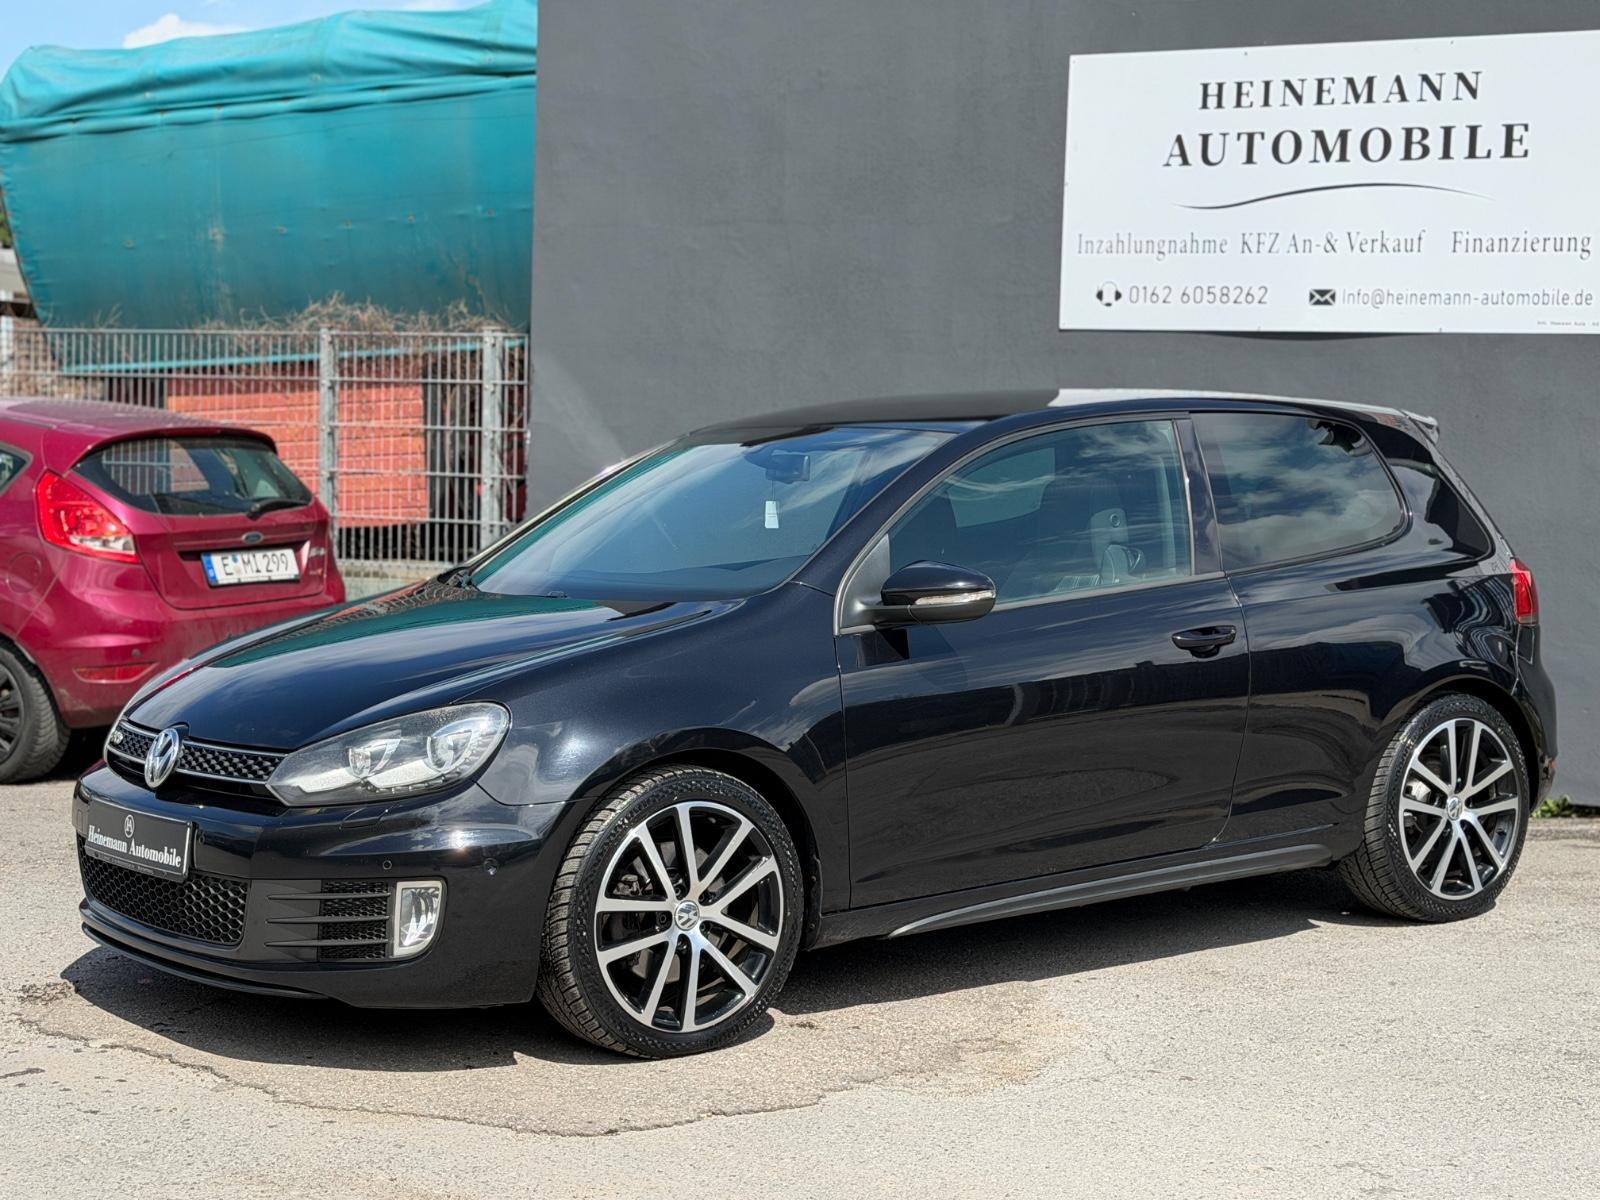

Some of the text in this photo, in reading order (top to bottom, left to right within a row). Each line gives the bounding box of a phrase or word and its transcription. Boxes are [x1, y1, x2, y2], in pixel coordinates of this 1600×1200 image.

[1198, 71, 1483, 110] HEINEMANN
[1162, 122, 1530, 167] AUTOMOBILE
[1077, 232, 1228, 261] Inzahlungnahme
[1240, 232, 1280, 254] KFZ
[1346, 229, 1427, 254] Verkauf
[1451, 231, 1592, 260] Finanzierung
[1128, 285, 1268, 305] 0162 6058262
[221, 556, 234, 576] E
[262, 552, 289, 573] 299
[88, 825, 128, 853] Heinemann
[129, 839, 182, 868] Automobile
